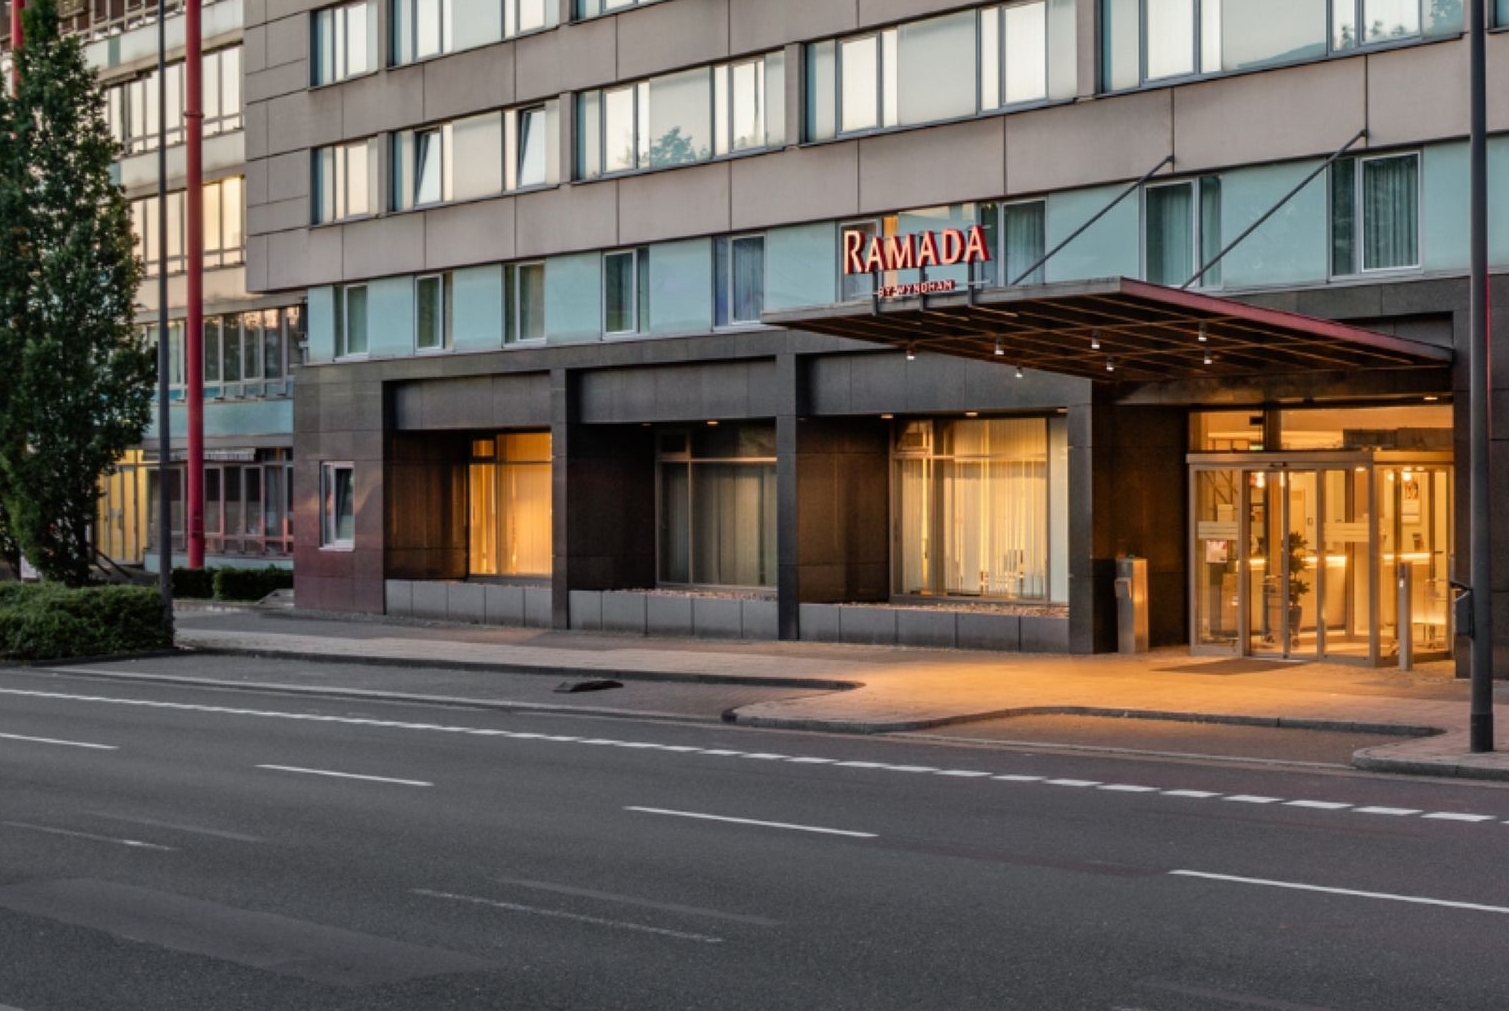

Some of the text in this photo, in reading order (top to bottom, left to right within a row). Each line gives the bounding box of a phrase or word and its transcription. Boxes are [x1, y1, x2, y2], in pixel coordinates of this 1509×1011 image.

[844, 225, 991, 274] RAMADA
[878, 279, 956, 297] BY WYNDHAM
